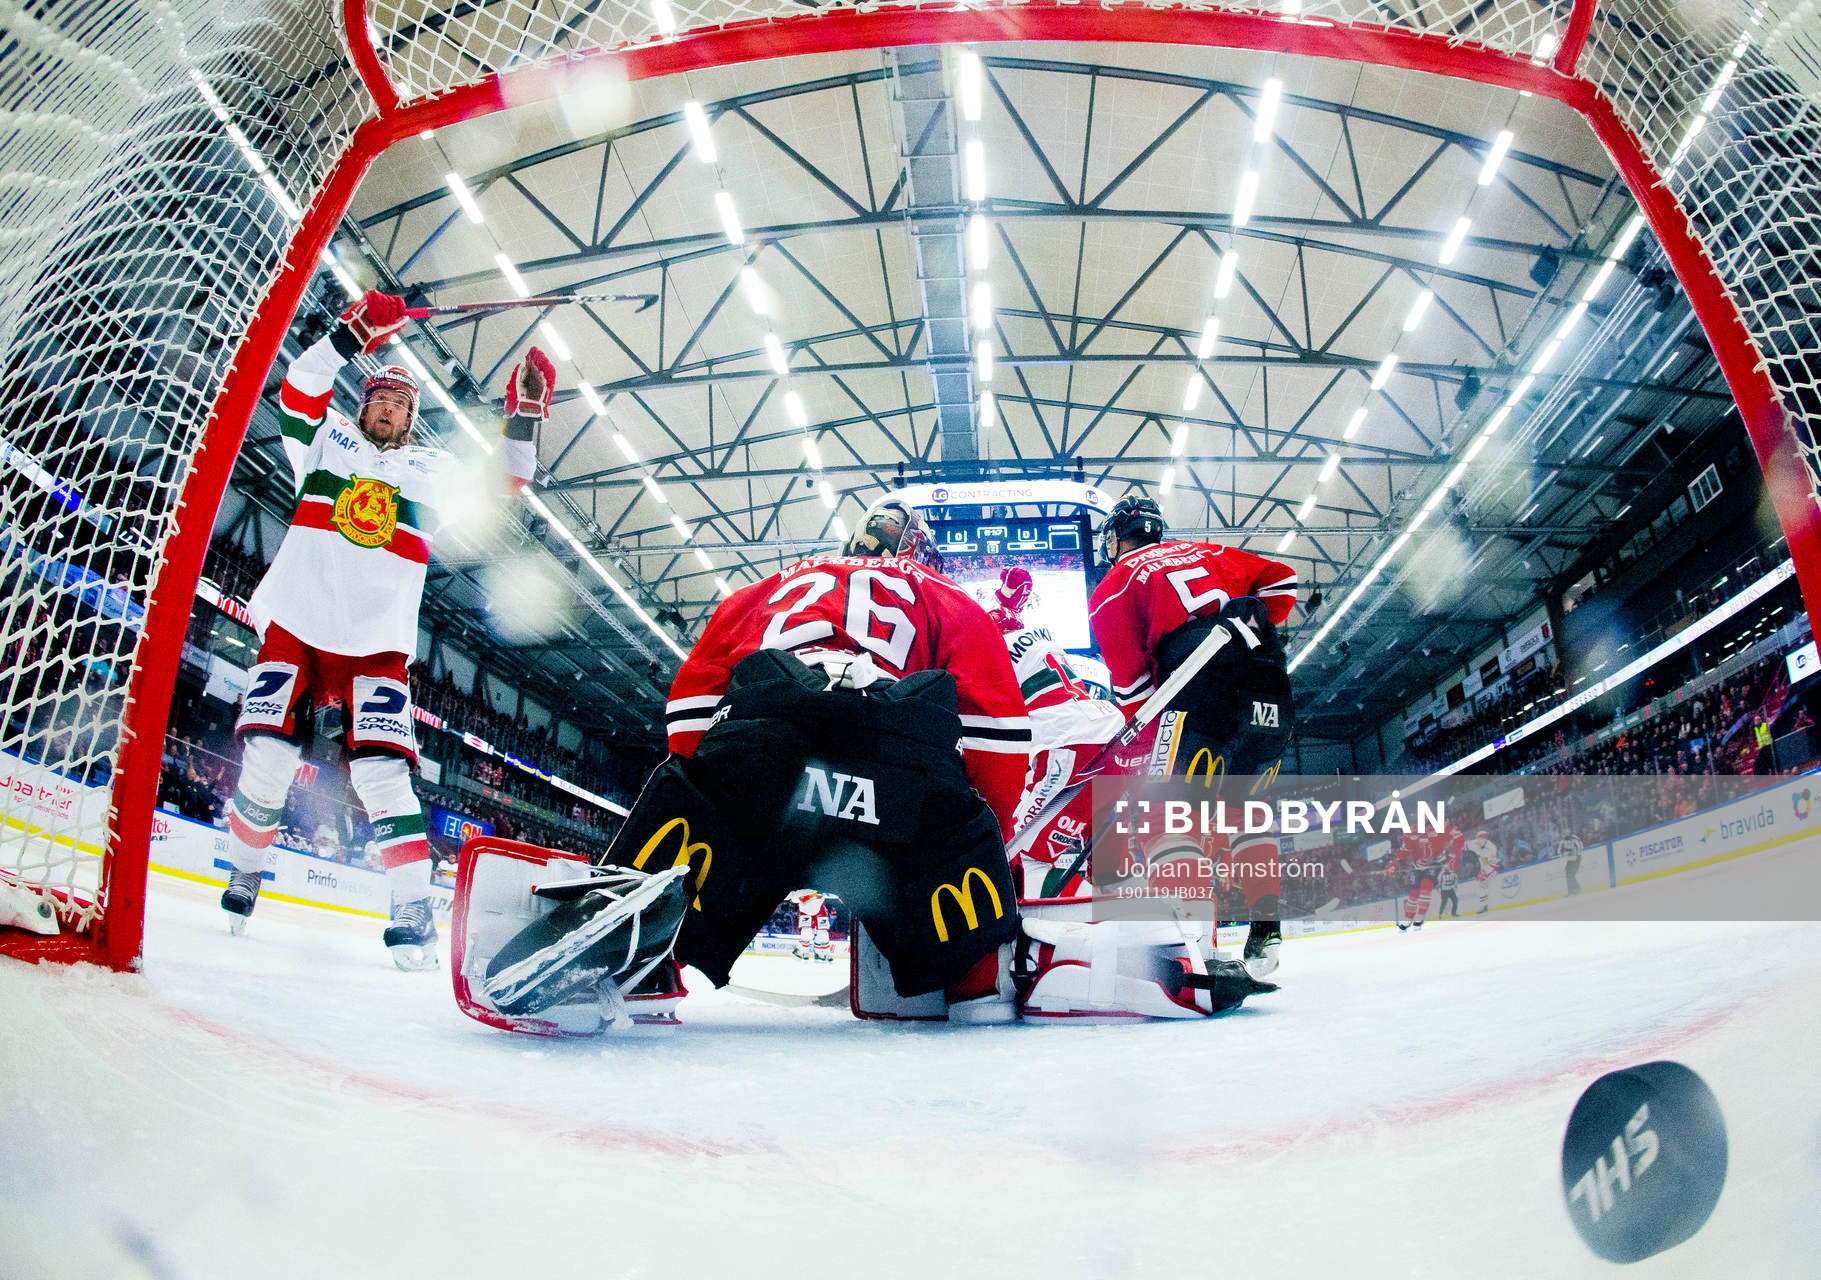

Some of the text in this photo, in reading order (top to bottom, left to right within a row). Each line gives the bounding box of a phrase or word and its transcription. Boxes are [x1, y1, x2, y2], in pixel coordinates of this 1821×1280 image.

[950, 488, 1033, 500] CONTRACTING
[1144, 521, 1152, 533] 5
[1165, 566, 1231, 614] 5
[758, 568, 917, 672] 26
[356, 716, 410, 732] JOHNS
[1250, 701, 1280, 728] NA
[356, 724, 410, 738] SPORT
[797, 766, 880, 825] NA
[444, 815, 483, 841] ELON
[1720, 805, 1775, 840] bravida
[1638, 835, 1685, 858] PISCATOR
[307, 868, 338, 889] Prinfo
